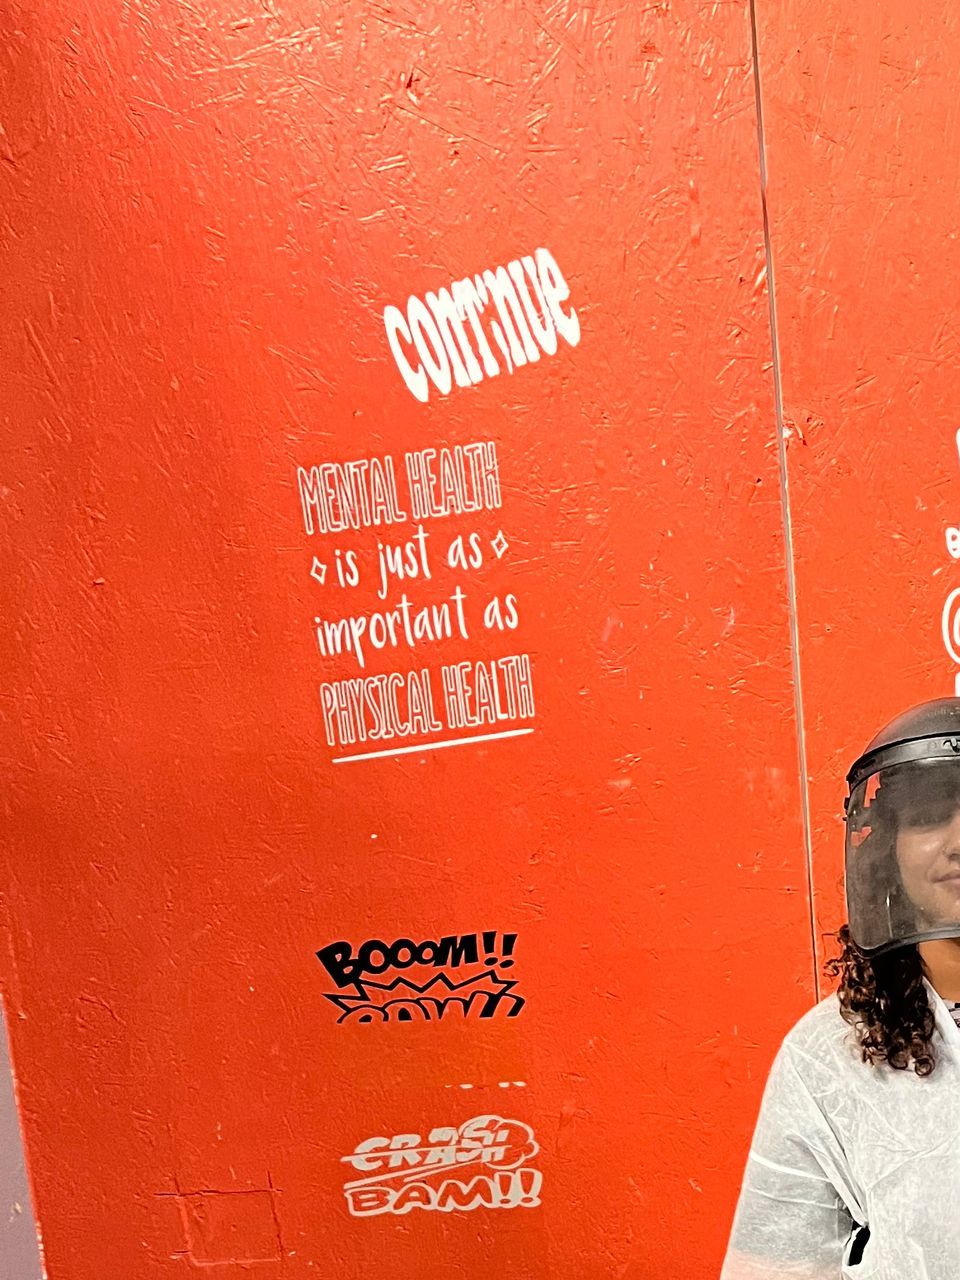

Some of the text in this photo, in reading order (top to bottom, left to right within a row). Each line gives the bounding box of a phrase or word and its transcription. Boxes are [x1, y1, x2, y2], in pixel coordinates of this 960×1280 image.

[297, 441, 503, 536] MENTAL HEALTH
[335, 524, 484, 600] is just as
[314, 585, 520, 669] important as
[319, 653, 535, 747] PHYSICAL HEALTH
[345, 1116, 512, 1171] CRASH
[343, 1167, 543, 1217] BAM!!
